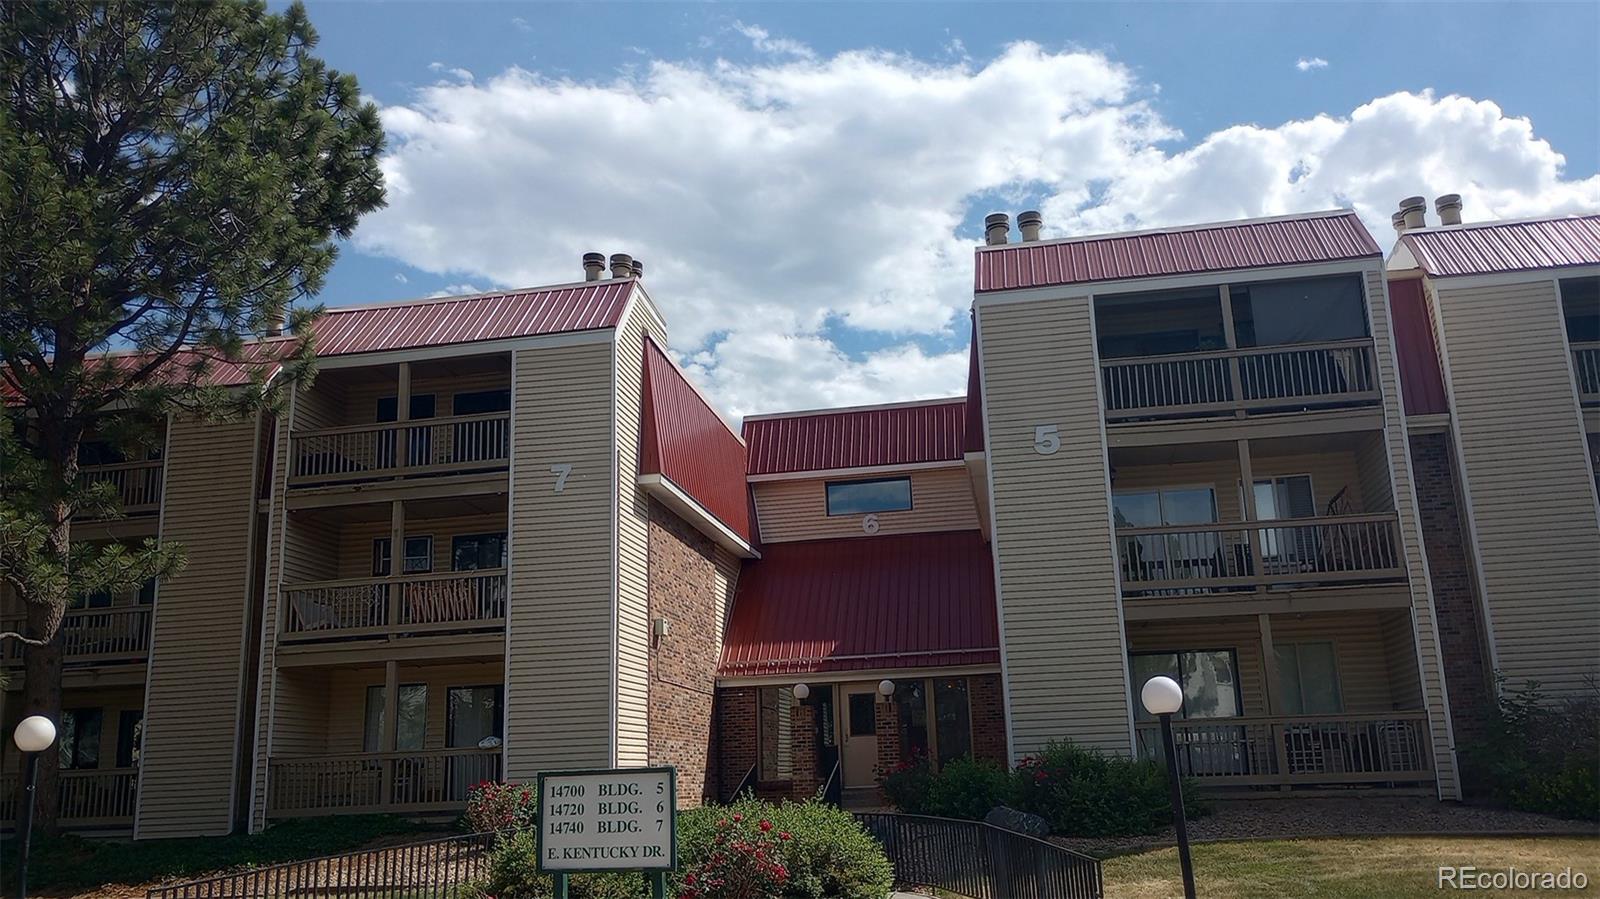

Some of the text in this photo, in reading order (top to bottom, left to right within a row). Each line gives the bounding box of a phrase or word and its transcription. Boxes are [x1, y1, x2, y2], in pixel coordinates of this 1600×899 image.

[1034, 424, 1060, 455] 5
[550, 463, 572, 492] 7
[863, 513, 880, 536] 6
[550, 782, 664, 798] 14700 BLDG. 5
[550, 800, 664, 816] 14720 BLDG. 6
[549, 819, 663, 835] 14740 BLDG. 7
[548, 845, 665, 860] E. KENTUCKY DR.
